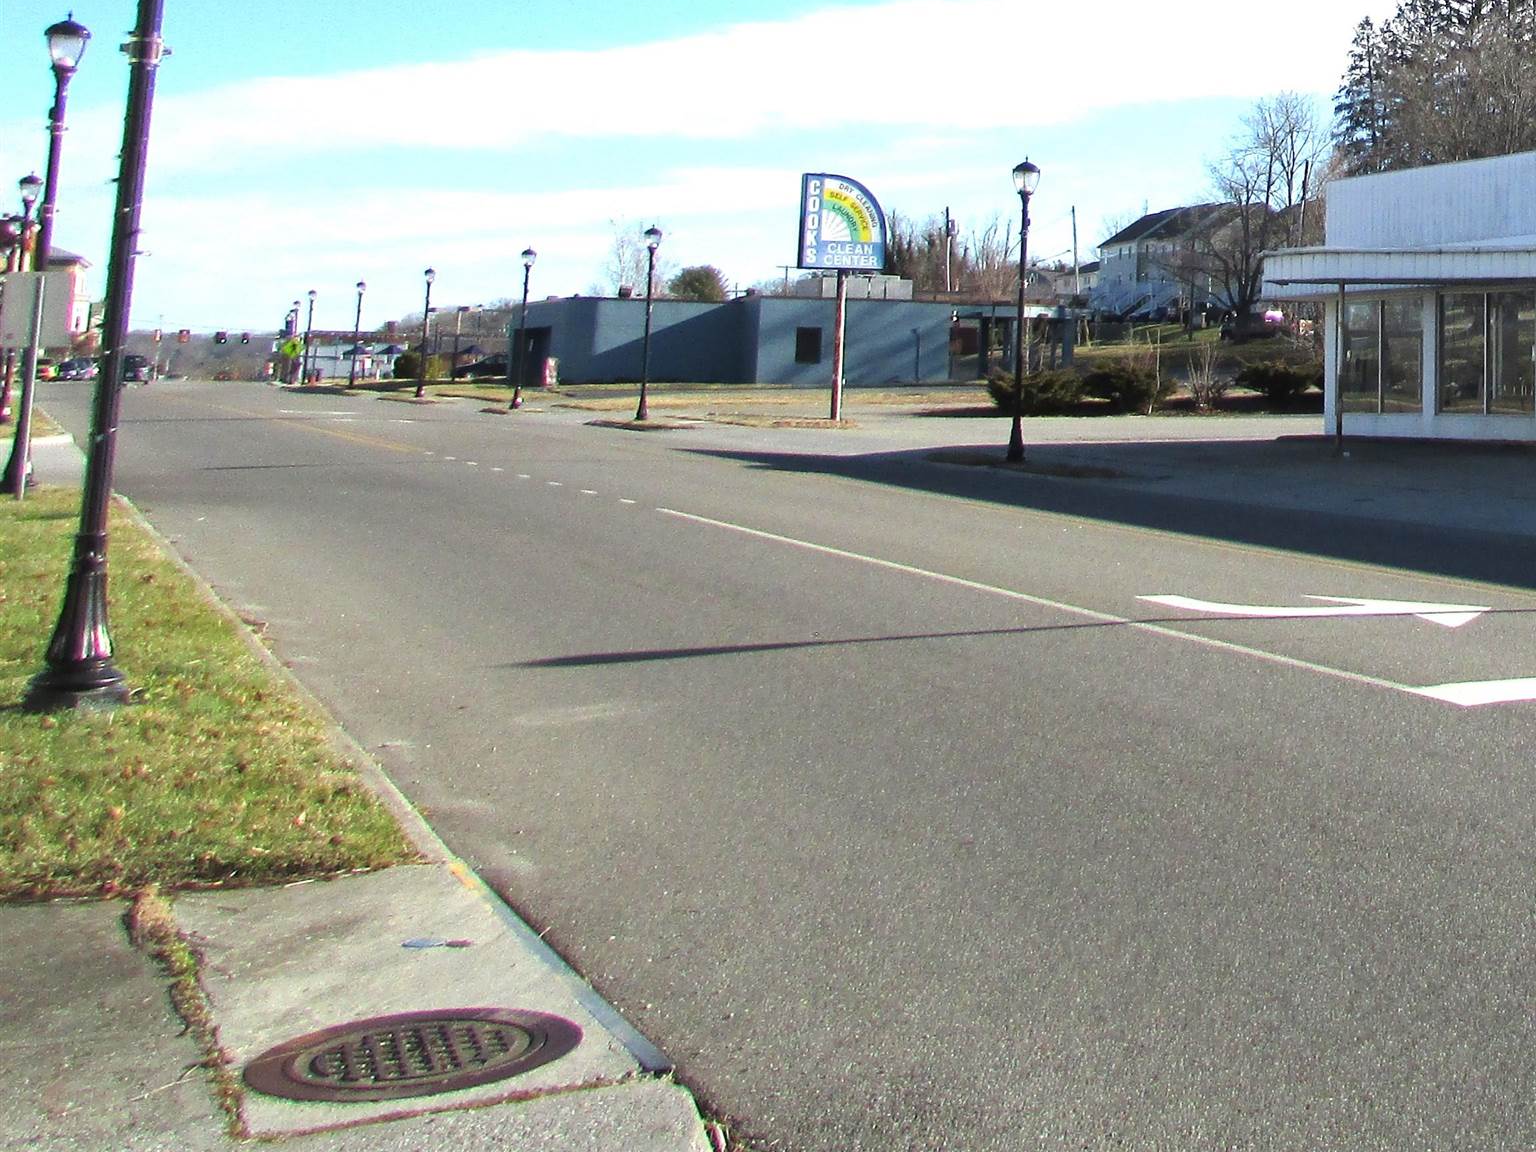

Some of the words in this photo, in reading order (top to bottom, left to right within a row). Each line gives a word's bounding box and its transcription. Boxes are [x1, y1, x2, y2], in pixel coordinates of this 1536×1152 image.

[830, 191, 848, 201] SELF
[838, 183, 854, 193] DRY
[856, 194, 877, 228] CLEANING
[832, 203, 858, 231] LAUNDRY
[827, 243, 873, 254] CLEAN
[823, 254, 877, 266] CENTER
